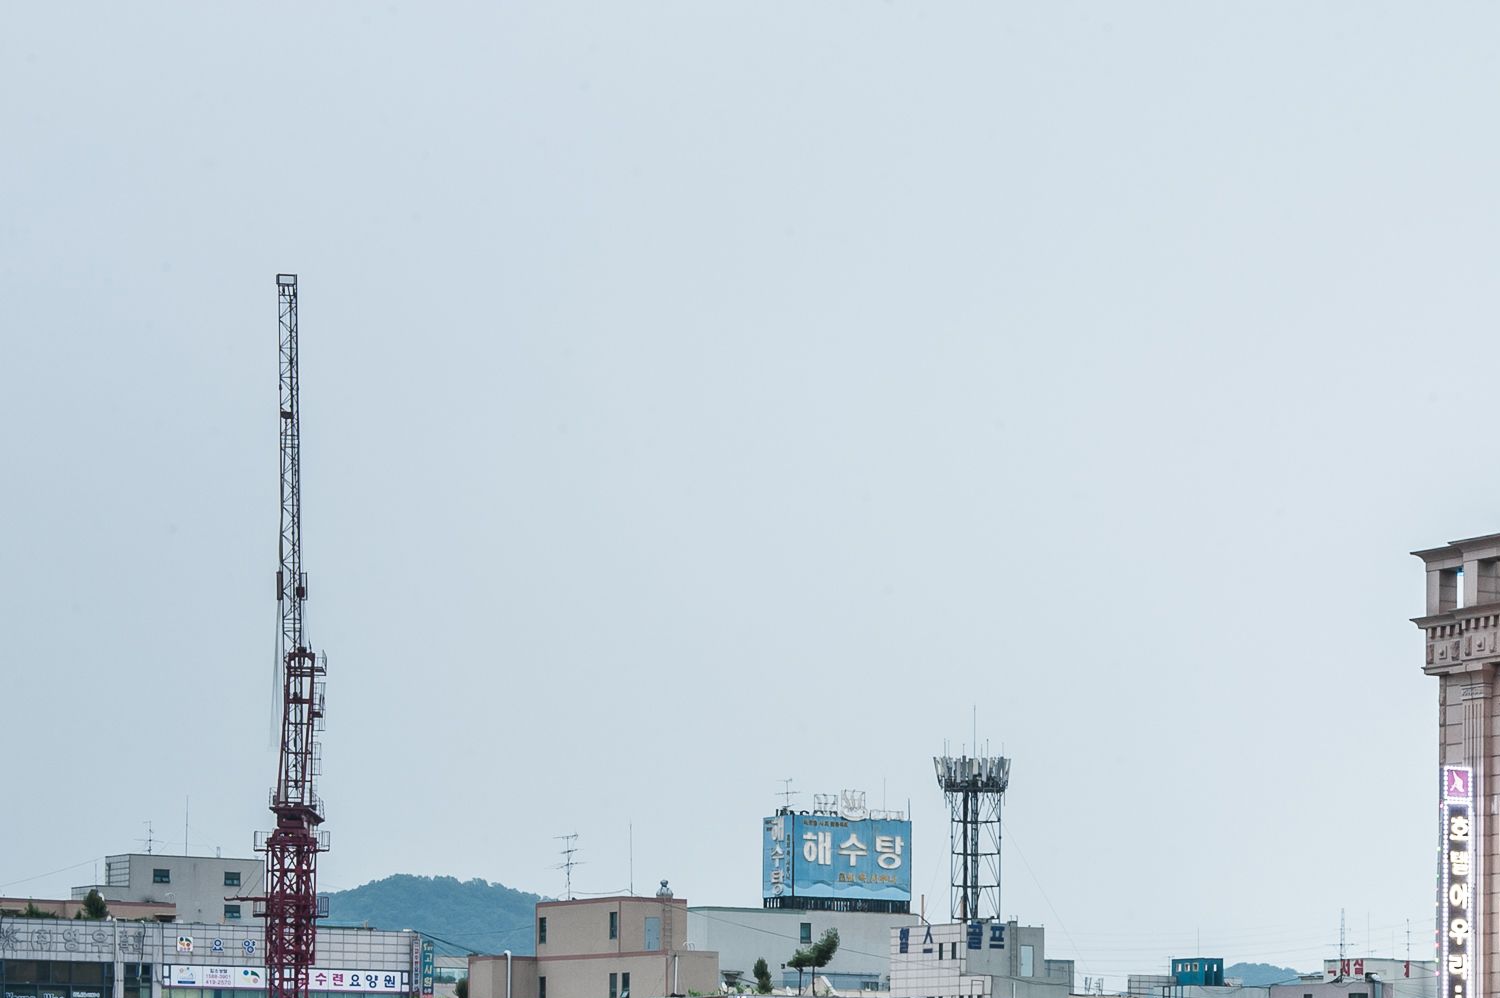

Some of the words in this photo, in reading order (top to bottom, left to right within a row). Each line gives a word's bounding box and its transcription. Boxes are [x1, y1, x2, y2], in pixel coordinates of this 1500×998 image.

[769, 815, 785, 895] 해수탕
[802, 831, 904, 870] 해수탕
[1448, 815, 1469, 981] 호텔아우라
